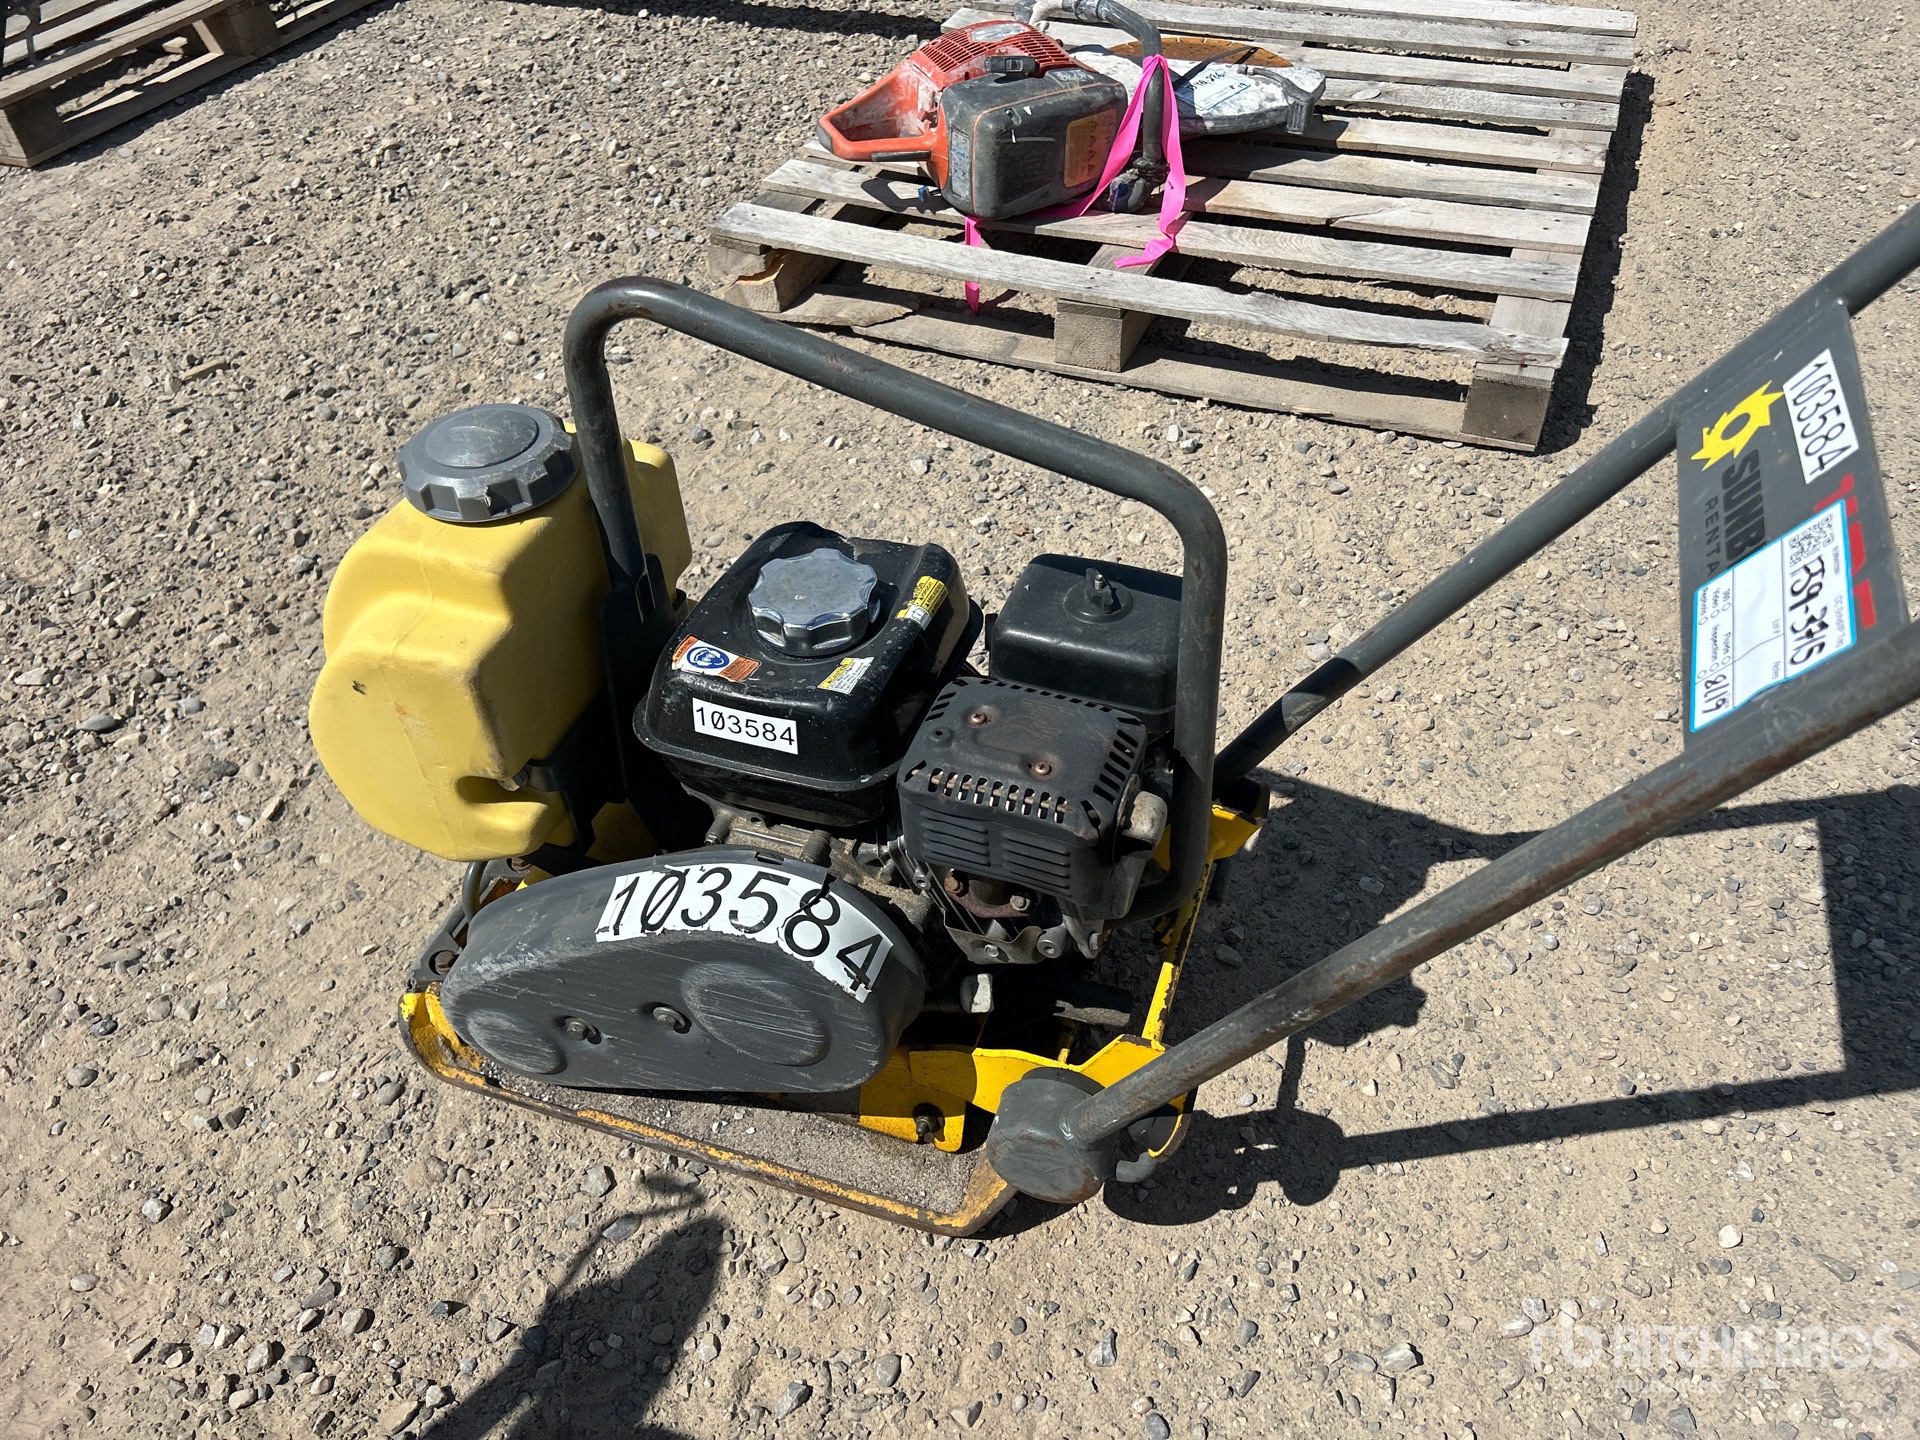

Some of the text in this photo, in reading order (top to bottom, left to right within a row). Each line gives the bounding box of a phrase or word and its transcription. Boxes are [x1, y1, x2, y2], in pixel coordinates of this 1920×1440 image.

[1790, 361, 1852, 476] 103584
[1705, 495, 1720, 577] RENTA
[1722, 449, 1766, 566] SUNB
[1710, 623, 1720, 662] Inspection
[696, 706, 795, 746] 103584
[613, 866, 883, 992] 103584
